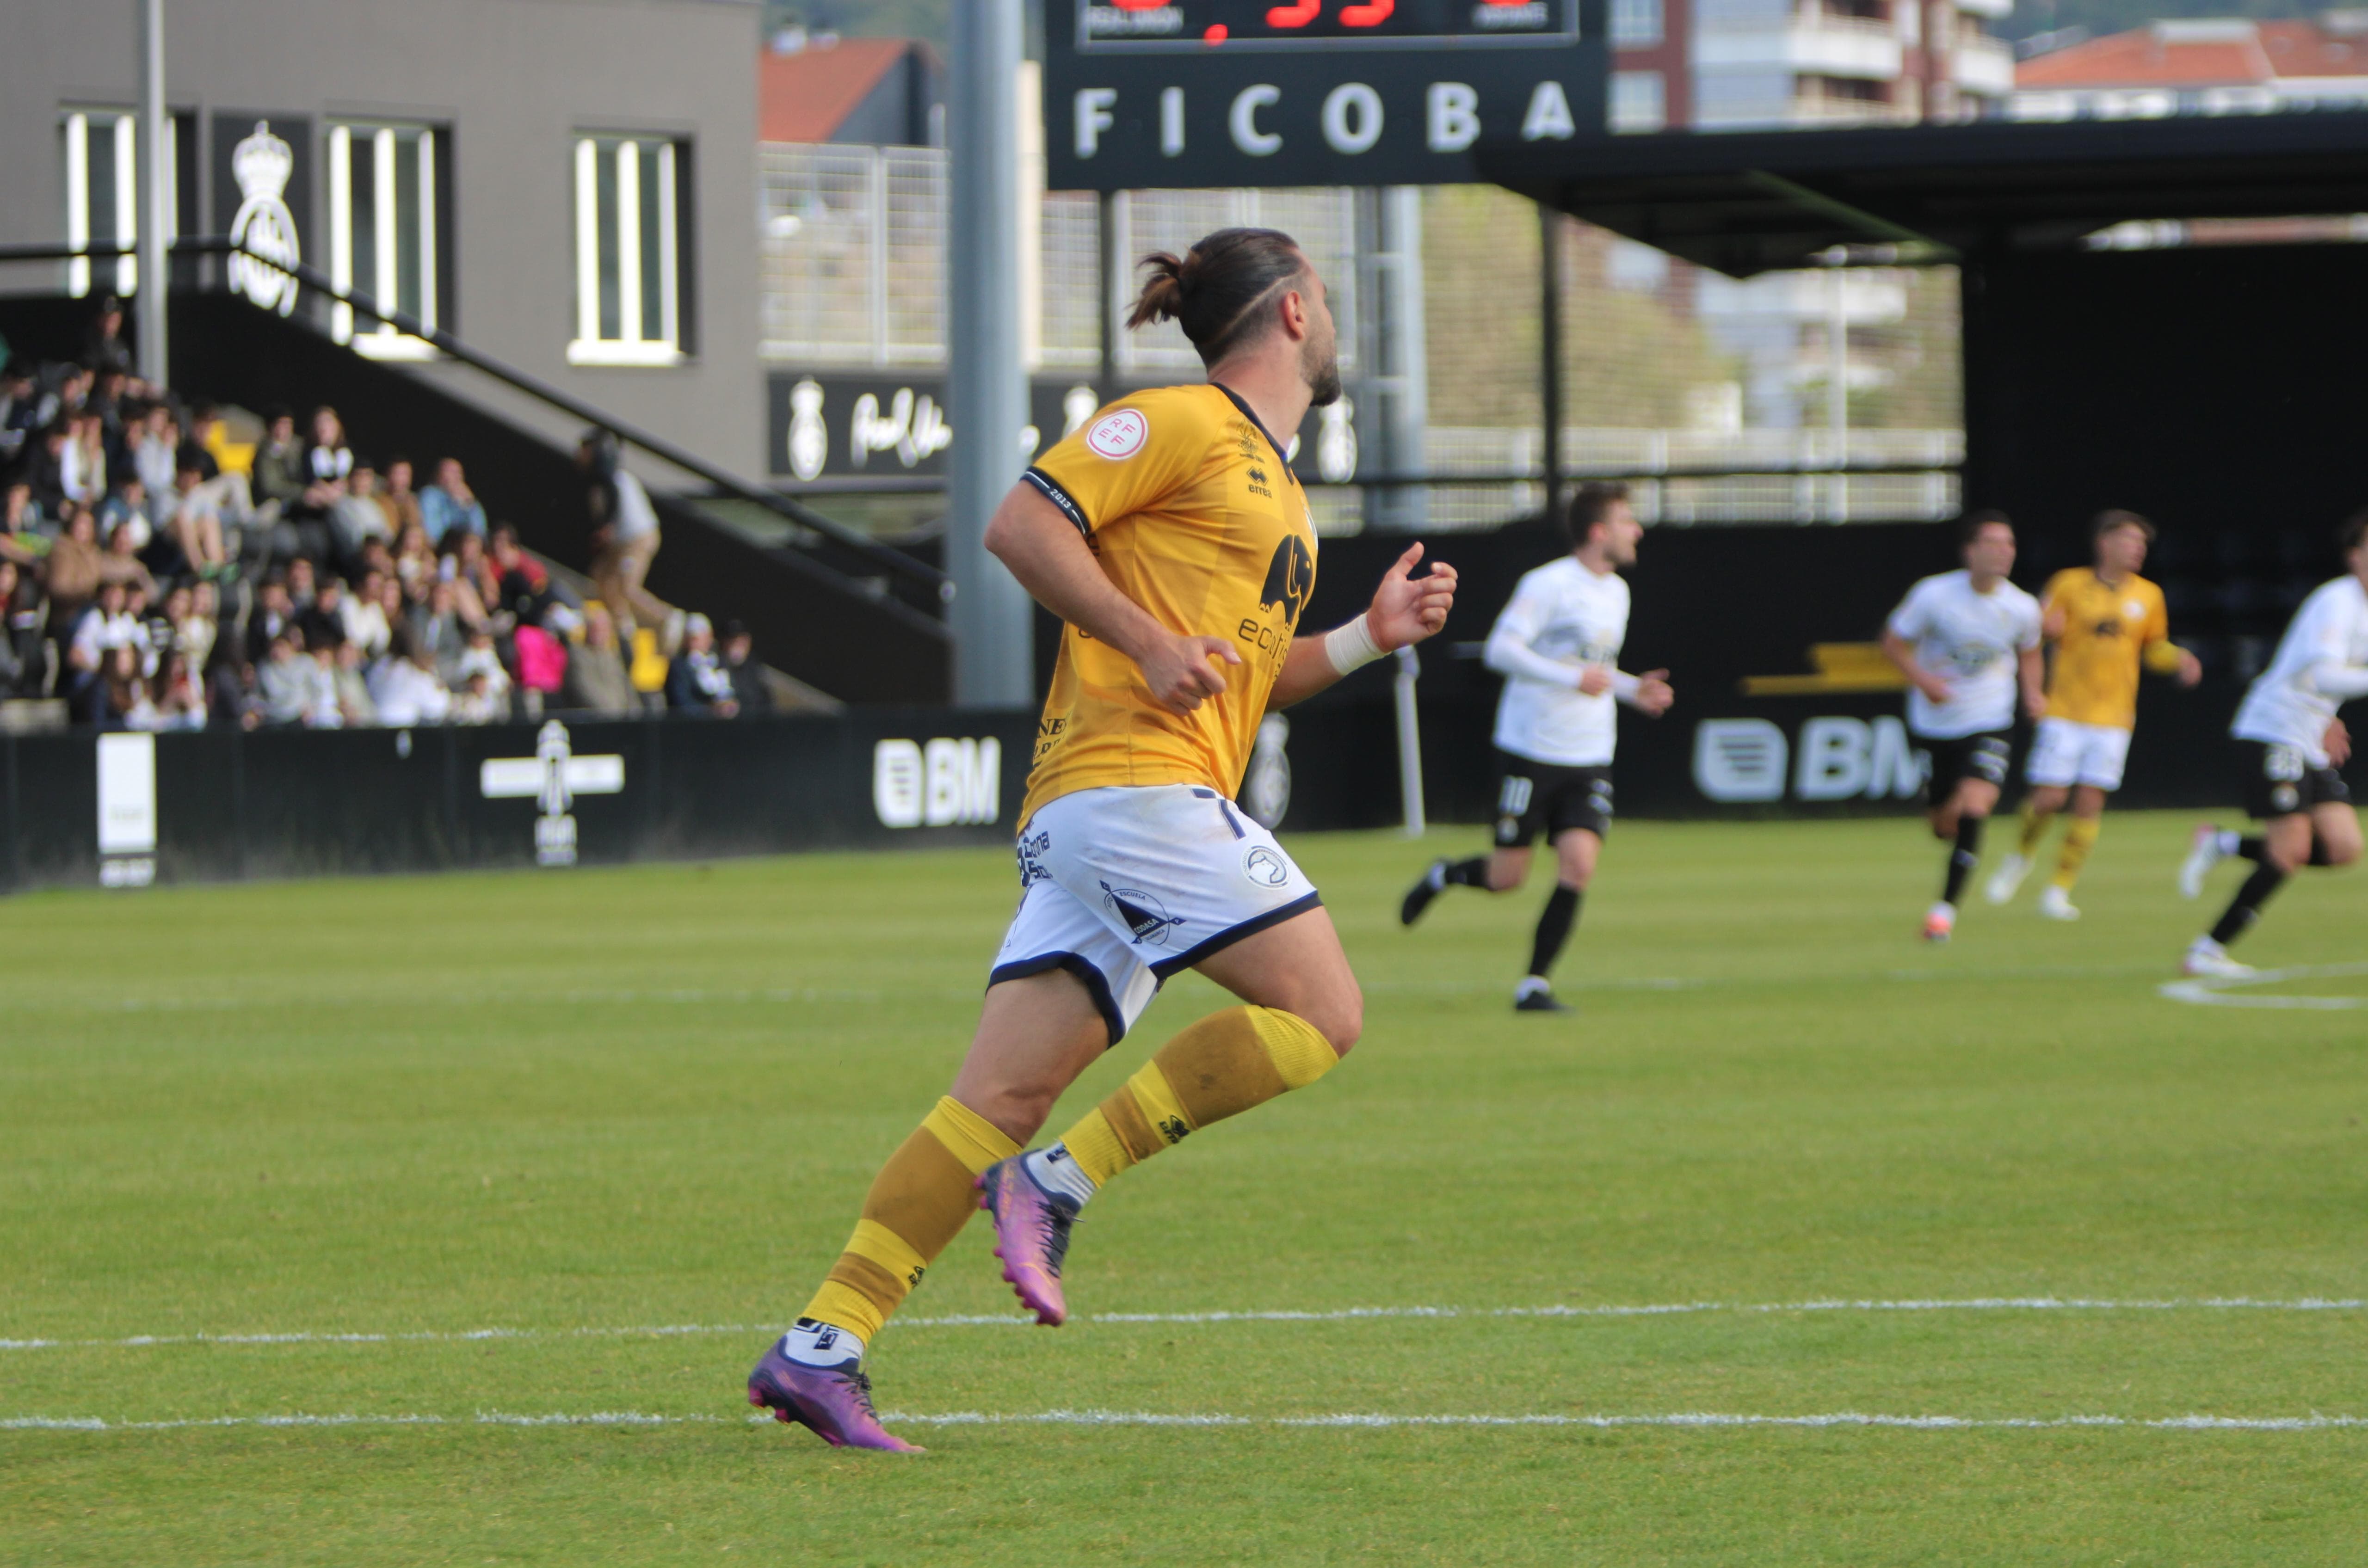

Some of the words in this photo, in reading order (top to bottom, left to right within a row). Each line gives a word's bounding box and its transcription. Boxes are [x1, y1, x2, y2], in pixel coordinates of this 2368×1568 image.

[1074, 81, 1575, 158] FICOBA
[1050, 489, 1072, 509] 2013
[924, 736, 1001, 826] BM
[1119, 891, 1146, 900] ESCUELA
[1134, 917, 1160, 934] CODASA
